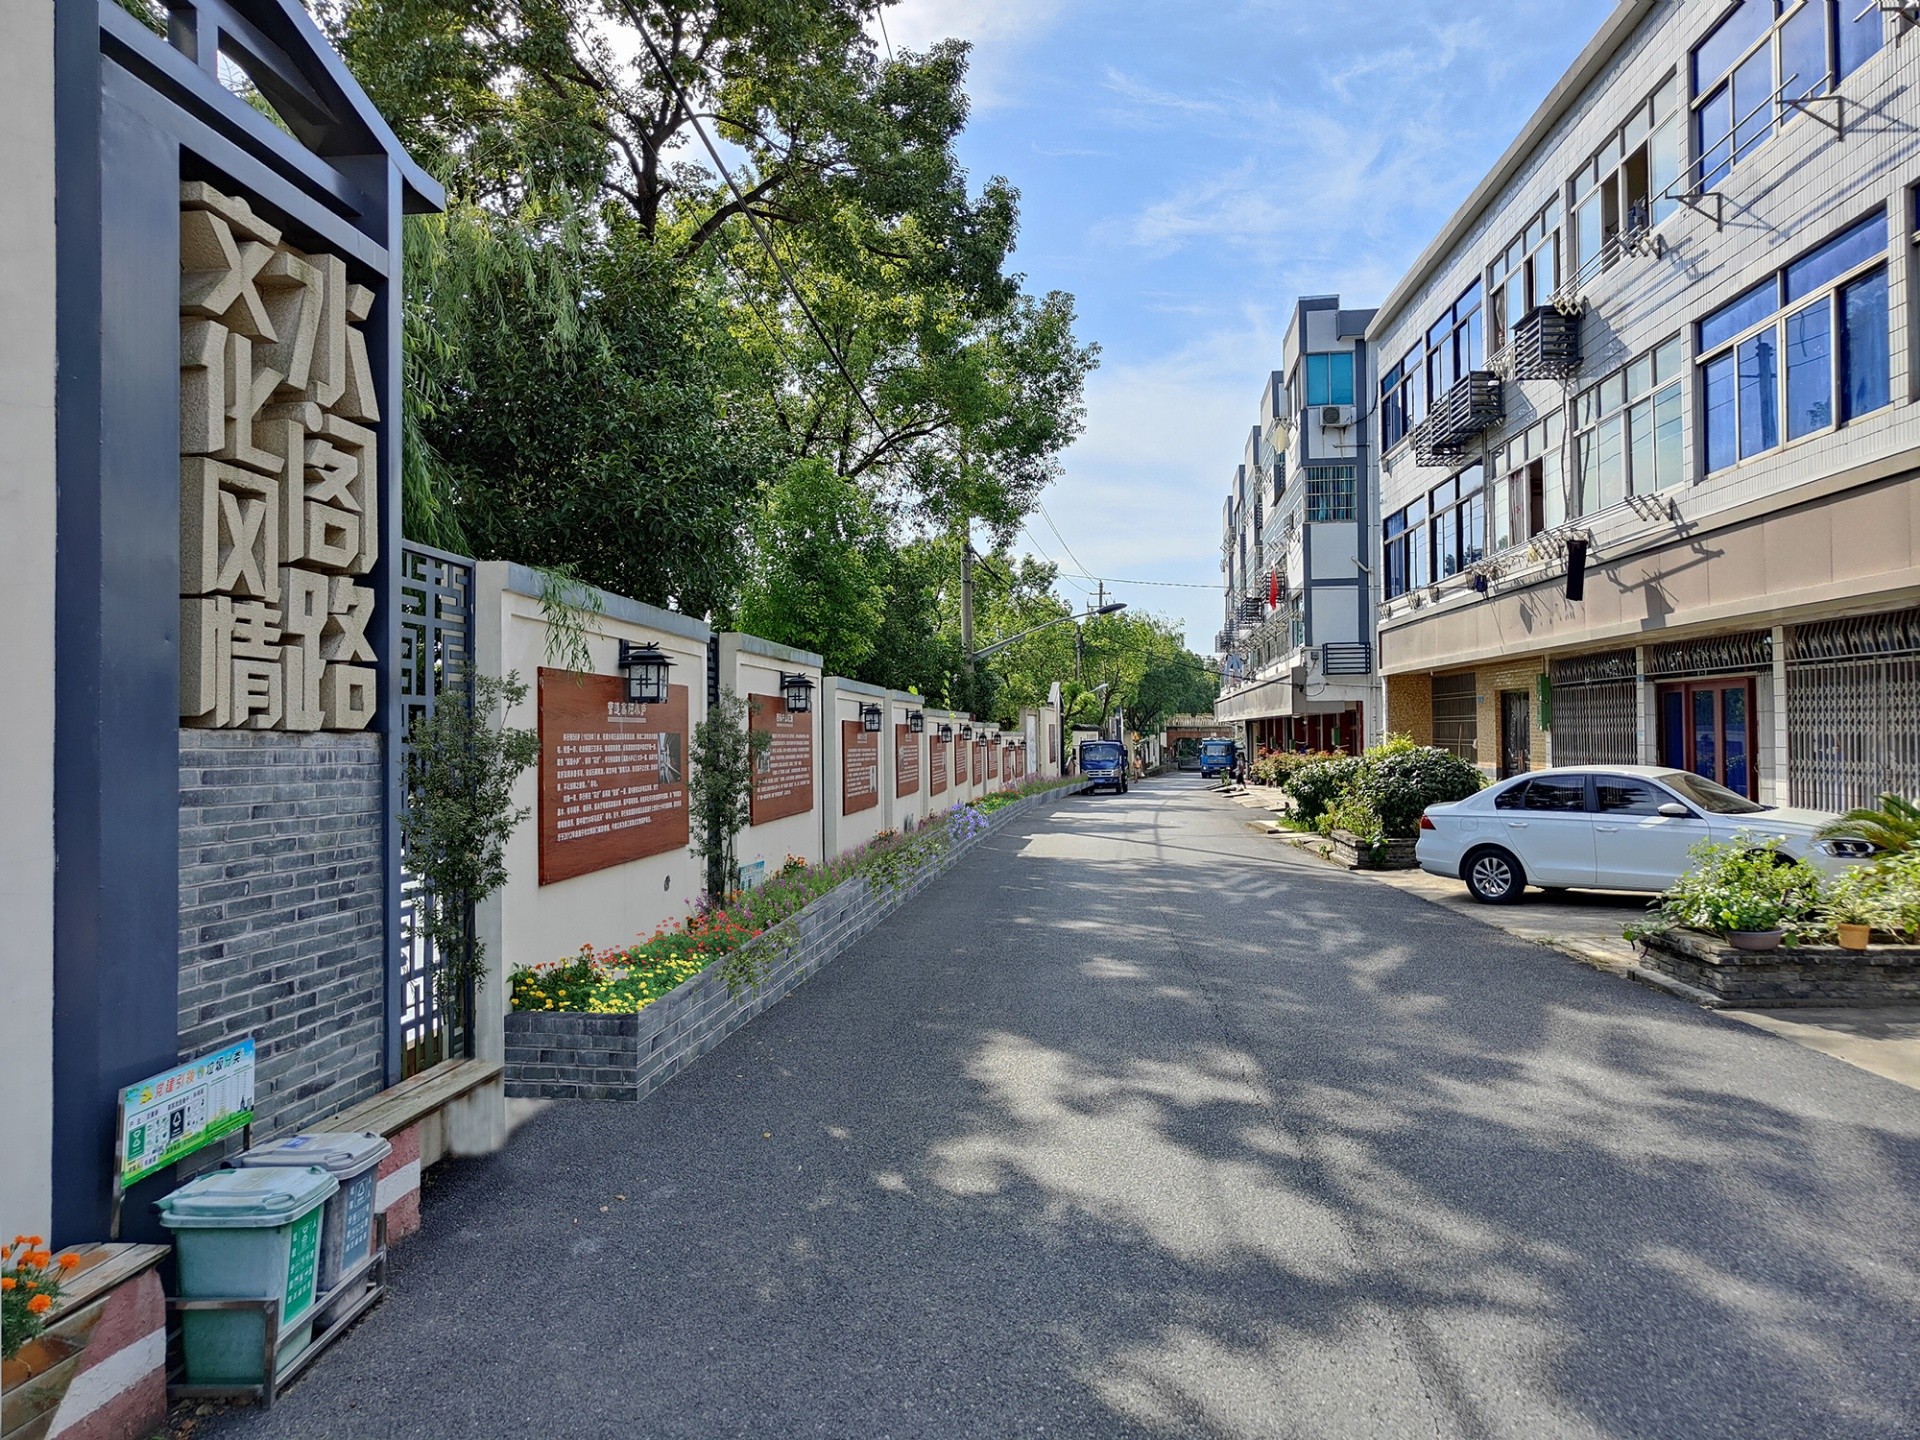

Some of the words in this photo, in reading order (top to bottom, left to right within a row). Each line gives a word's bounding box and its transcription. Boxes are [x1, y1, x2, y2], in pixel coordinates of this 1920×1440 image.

[181, 180, 283, 729] 文化风情
[268, 252, 381, 731] 水阁路
[154, 1067, 197, 1100] 党建引领
[205, 1049, 242, 1077] 垃圾分类
